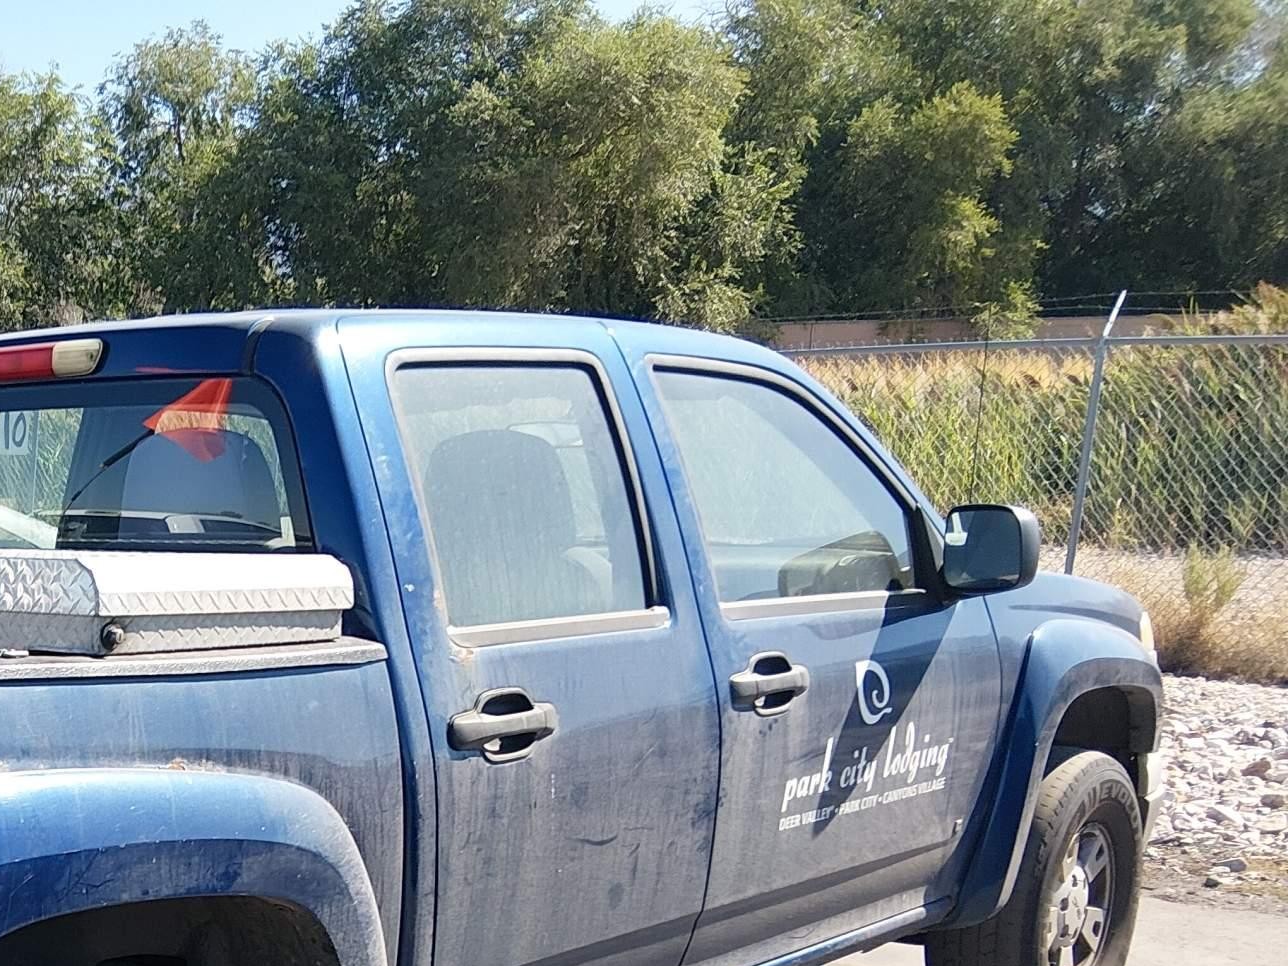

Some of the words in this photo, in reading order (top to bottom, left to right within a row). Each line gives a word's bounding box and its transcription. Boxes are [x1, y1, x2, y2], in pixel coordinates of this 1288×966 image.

[4, 411, 27, 450] 10
[781, 737, 833, 812] park
[840, 746, 877, 792] city
[883, 721, 951, 784] lodging
[779, 814, 801, 831] DEER
[839, 799, 861, 816] PARK
